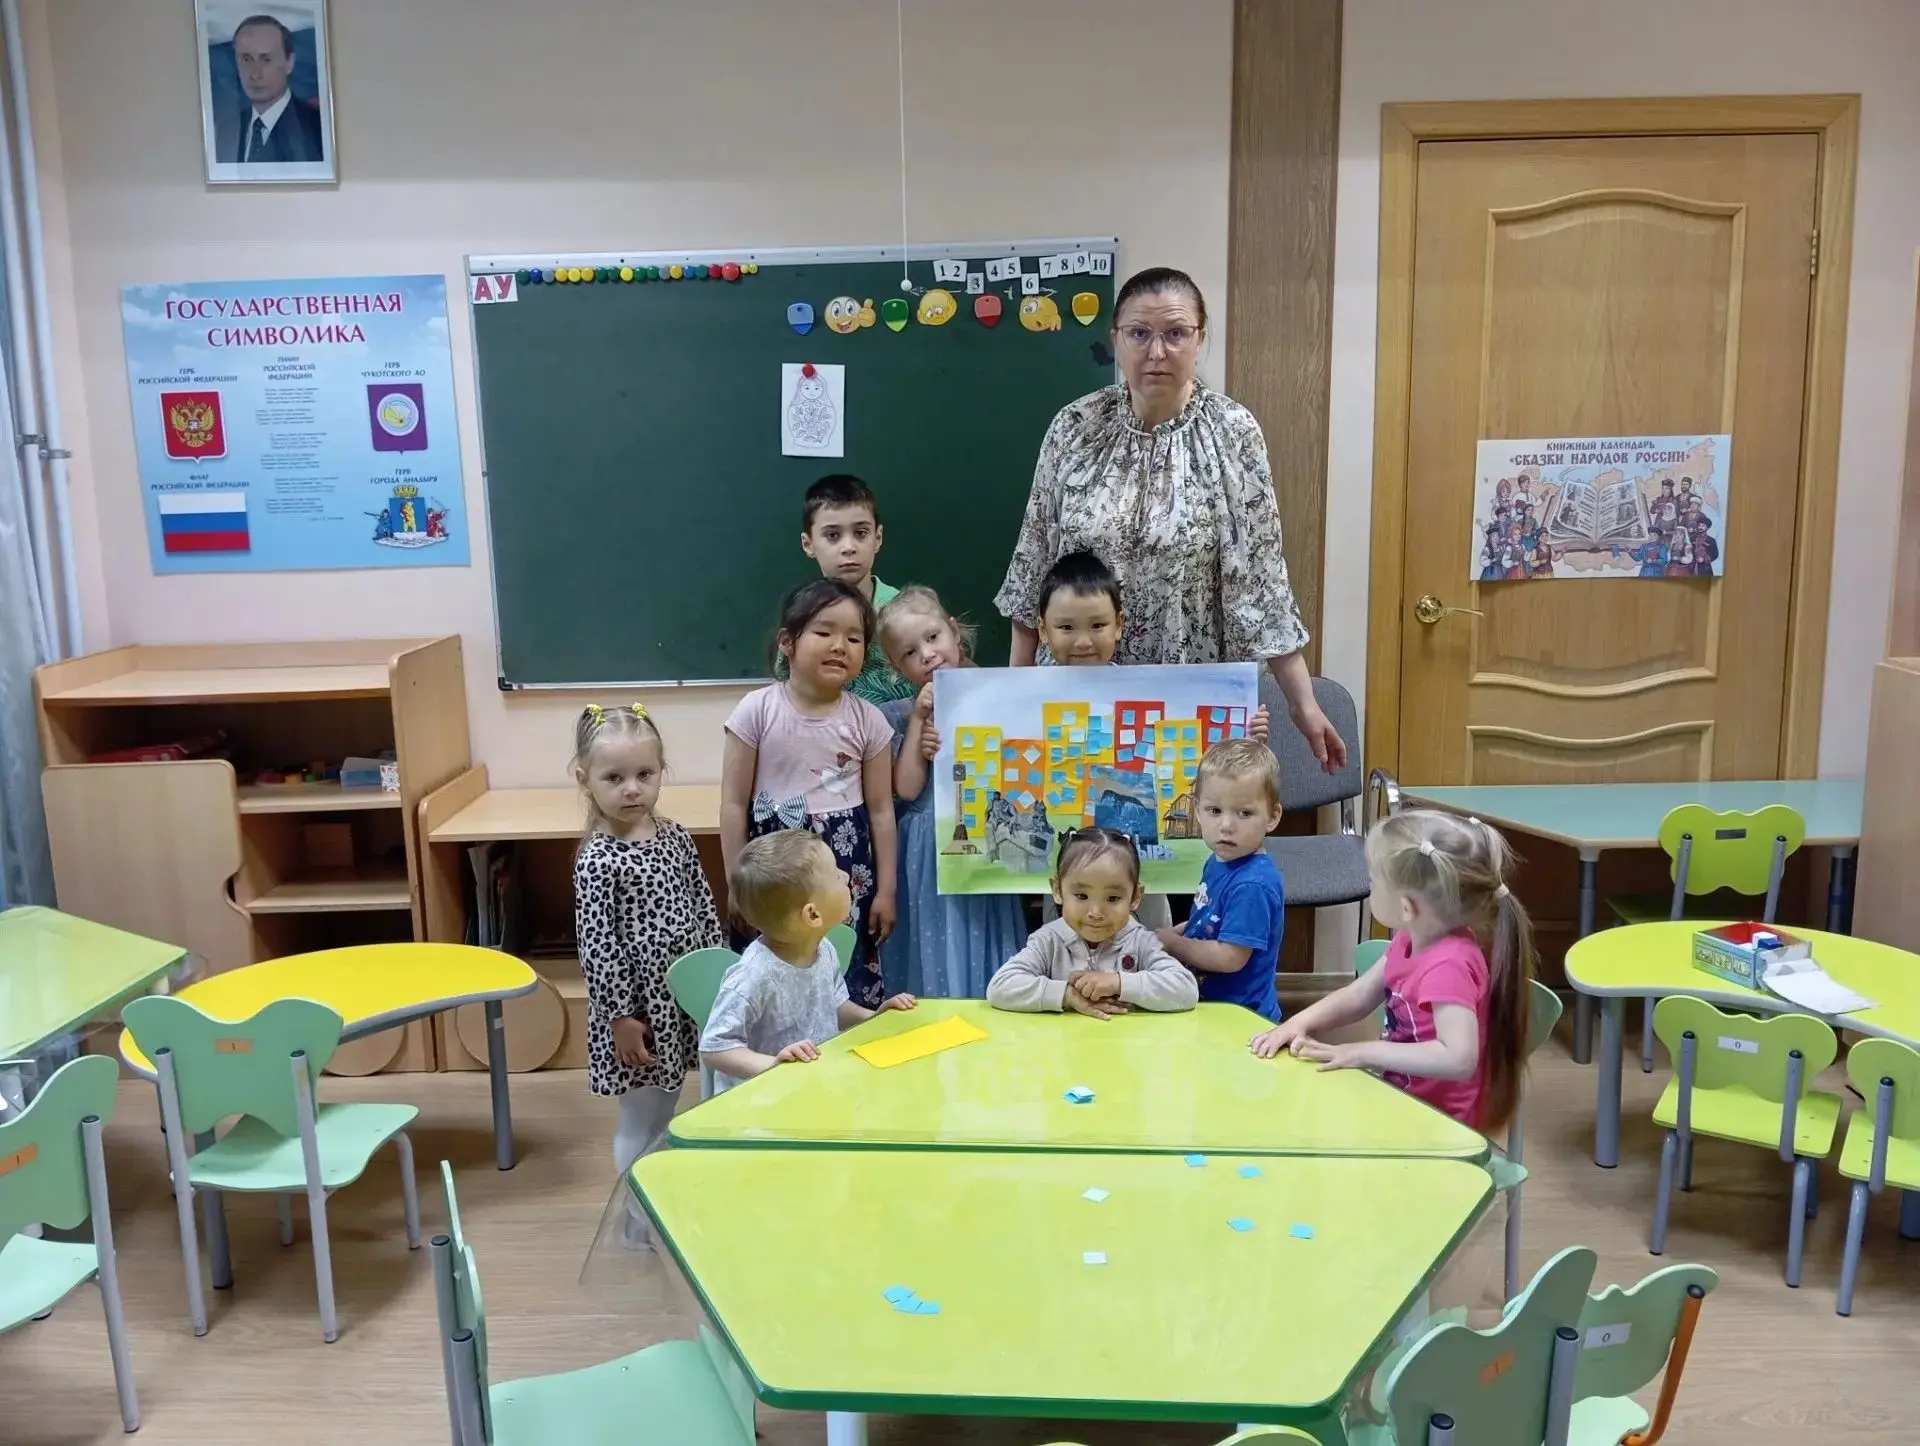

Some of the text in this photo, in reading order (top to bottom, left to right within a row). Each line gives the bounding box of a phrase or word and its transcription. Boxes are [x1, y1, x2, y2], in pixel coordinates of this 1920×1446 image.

[940, 255, 1107, 290] 1 2 3 4 5 6 7 8 9 10
[166, 294, 402, 319] ГОСУДАРСТВЕННАЯ
[207, 324, 366, 347] СИМВОЛИКА
[384, 361, 400, 369] ГЕРБ
[179, 367, 195, 375] ГЕРБ
[361, 370, 411, 378] ЧУКОТСКОГО
[138, 375, 190, 384] РОССИЙСКОЙ
[1547, 440, 1655, 451] КНИЖНЫЙ КАЛЕНДАРЬ
[1509, 451, 1691, 466] «СКАЗКИ НАРОДОВ РОССИИ»
